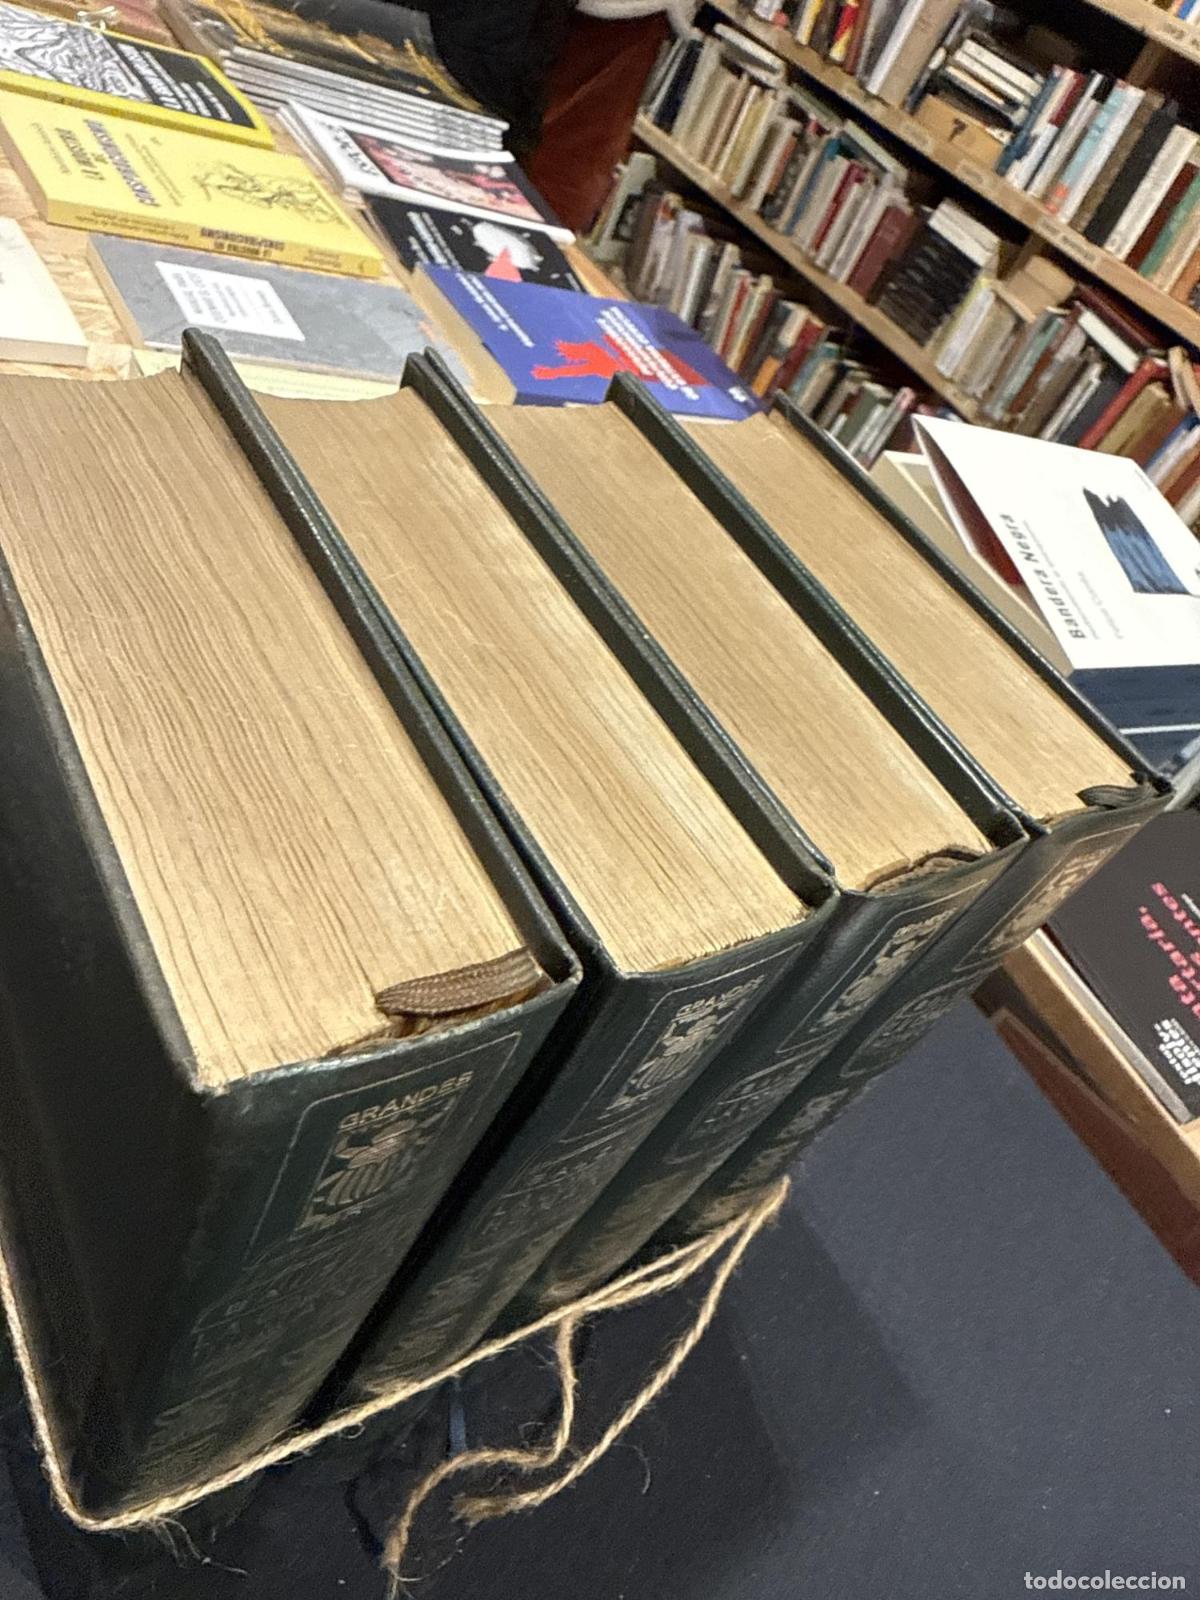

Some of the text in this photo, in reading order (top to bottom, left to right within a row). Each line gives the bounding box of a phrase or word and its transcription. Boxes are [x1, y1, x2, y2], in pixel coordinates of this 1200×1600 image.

[1000, 513, 1039, 564] Negra
[1033, 567, 1087, 639] Bandera
[338, 1070, 474, 1131] GRANDES
